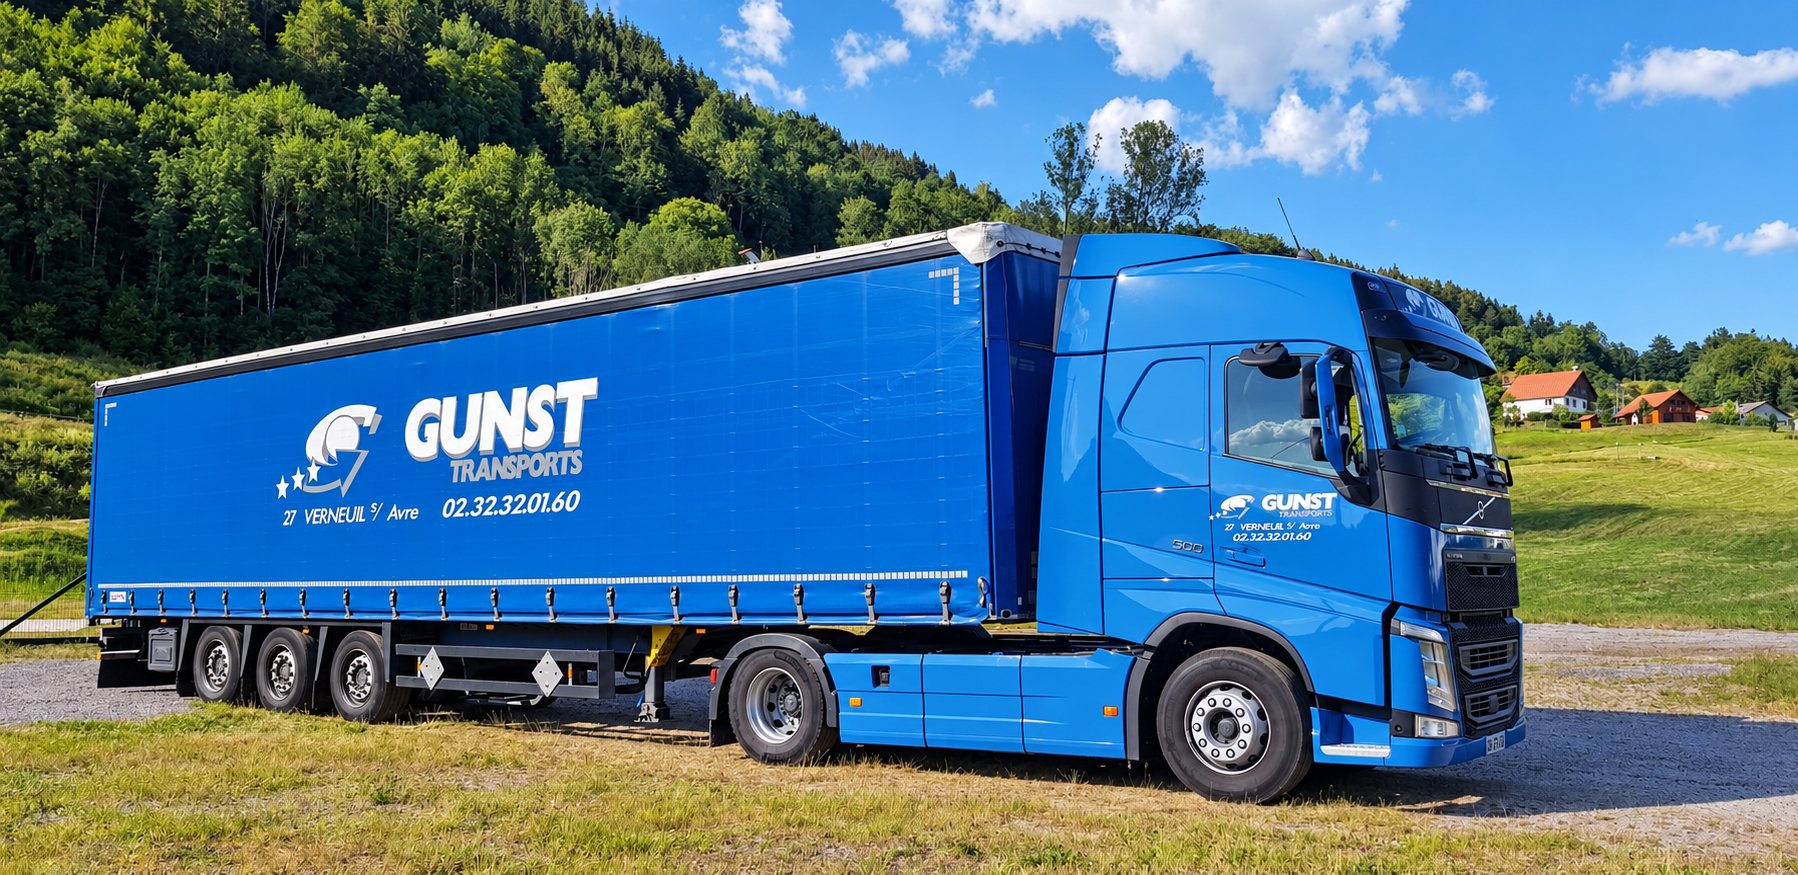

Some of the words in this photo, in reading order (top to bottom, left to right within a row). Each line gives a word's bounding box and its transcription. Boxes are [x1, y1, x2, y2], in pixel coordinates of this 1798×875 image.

[405, 377, 598, 462] GUNST
[449, 449, 583, 483] TRANSPORTS
[442, 489, 581, 518] 02.32.32.01.60
[1261, 492, 1338, 512] GUNST
[283, 509, 297, 526] 27
[304, 506, 366, 525] VERNEUIL
[387, 505, 419, 521] Avre
[1279, 509, 1333, 519] TRANSPORTS
[1224, 523, 1235, 532] 27
[1240, 522, 1284, 531] VERNEUIL
[1232, 531, 1312, 543] 02.32.32.01.60
[1172, 539, 1204, 554] 500
